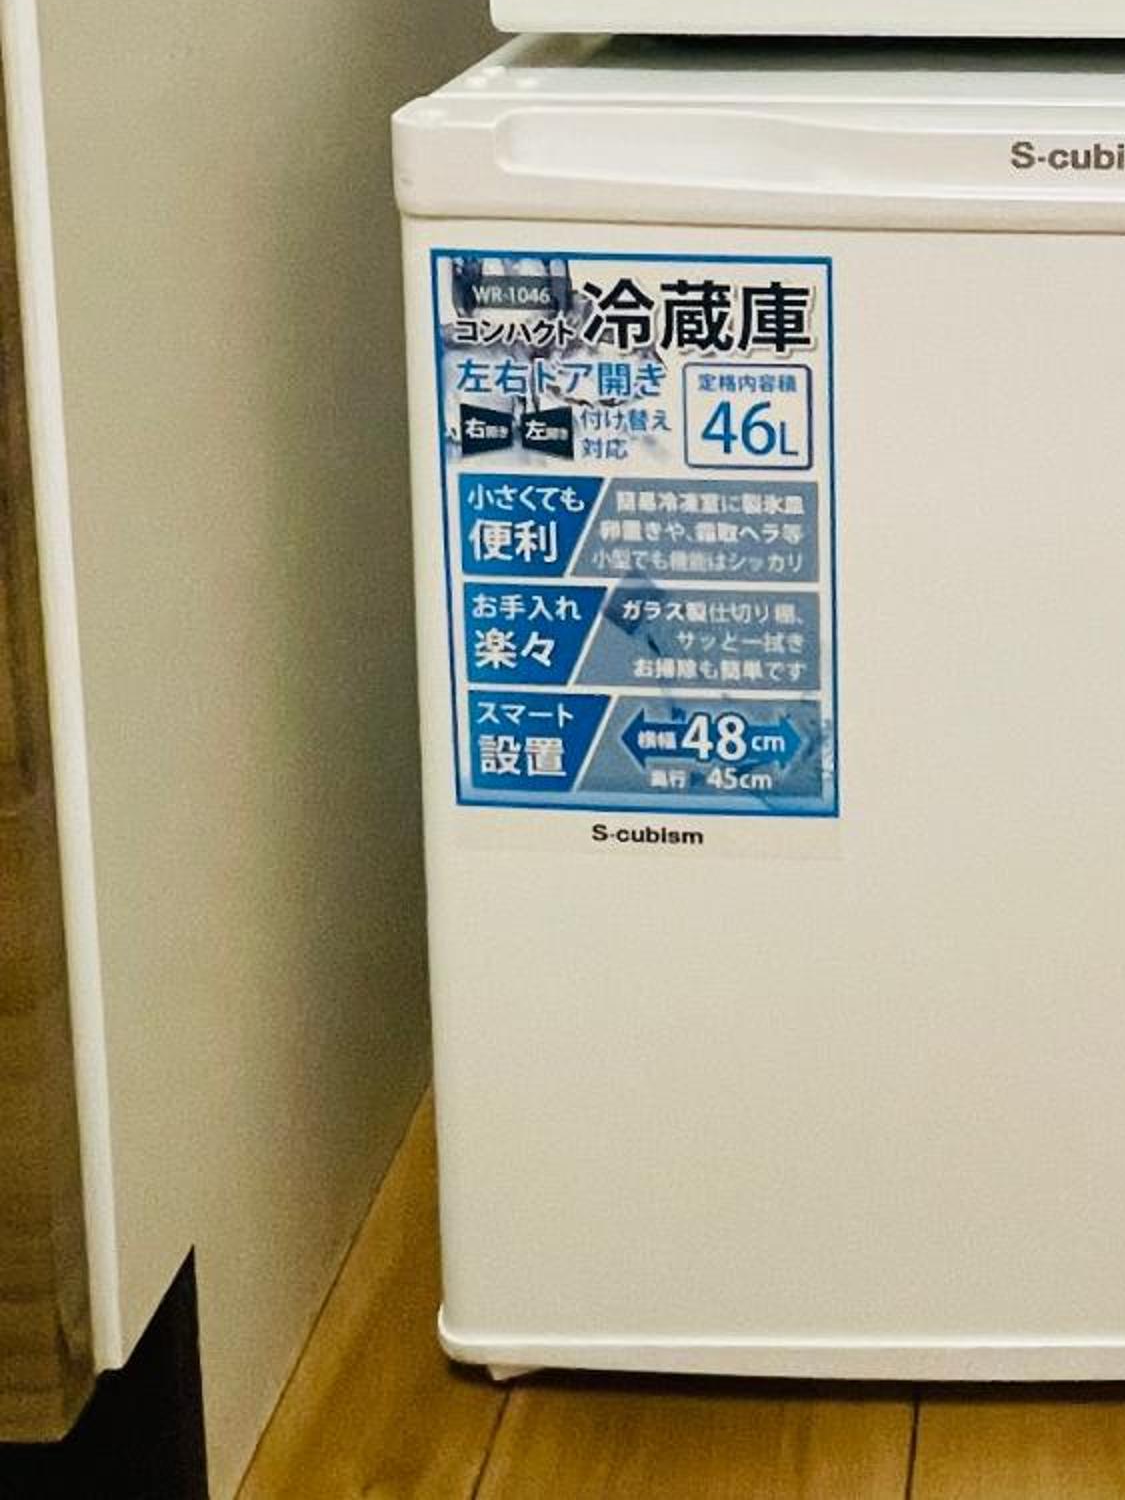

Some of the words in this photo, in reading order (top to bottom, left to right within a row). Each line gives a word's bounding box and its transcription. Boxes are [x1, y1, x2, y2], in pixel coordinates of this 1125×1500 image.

[471, 285, 550, 304] WR-1046
[581, 277, 813, 353] 冷蔵庫
[456, 358, 667, 398] 左右ドア開き
[697, 373, 798, 394] 定格内容積
[579, 408, 672, 432] 付け替え
[700, 400, 800, 457] 46L
[581, 438, 629, 460] 対応
[467, 483, 586, 513] 小さくても
[468, 518, 559, 564] 便利
[471, 593, 583, 622] お手入れ
[474, 627, 556, 670] 楽々
[476, 701, 575, 729] スマート
[478, 734, 568, 777] 設置
[705, 766, 774, 790] 45cm
[591, 823, 705, 846] S-cubism
